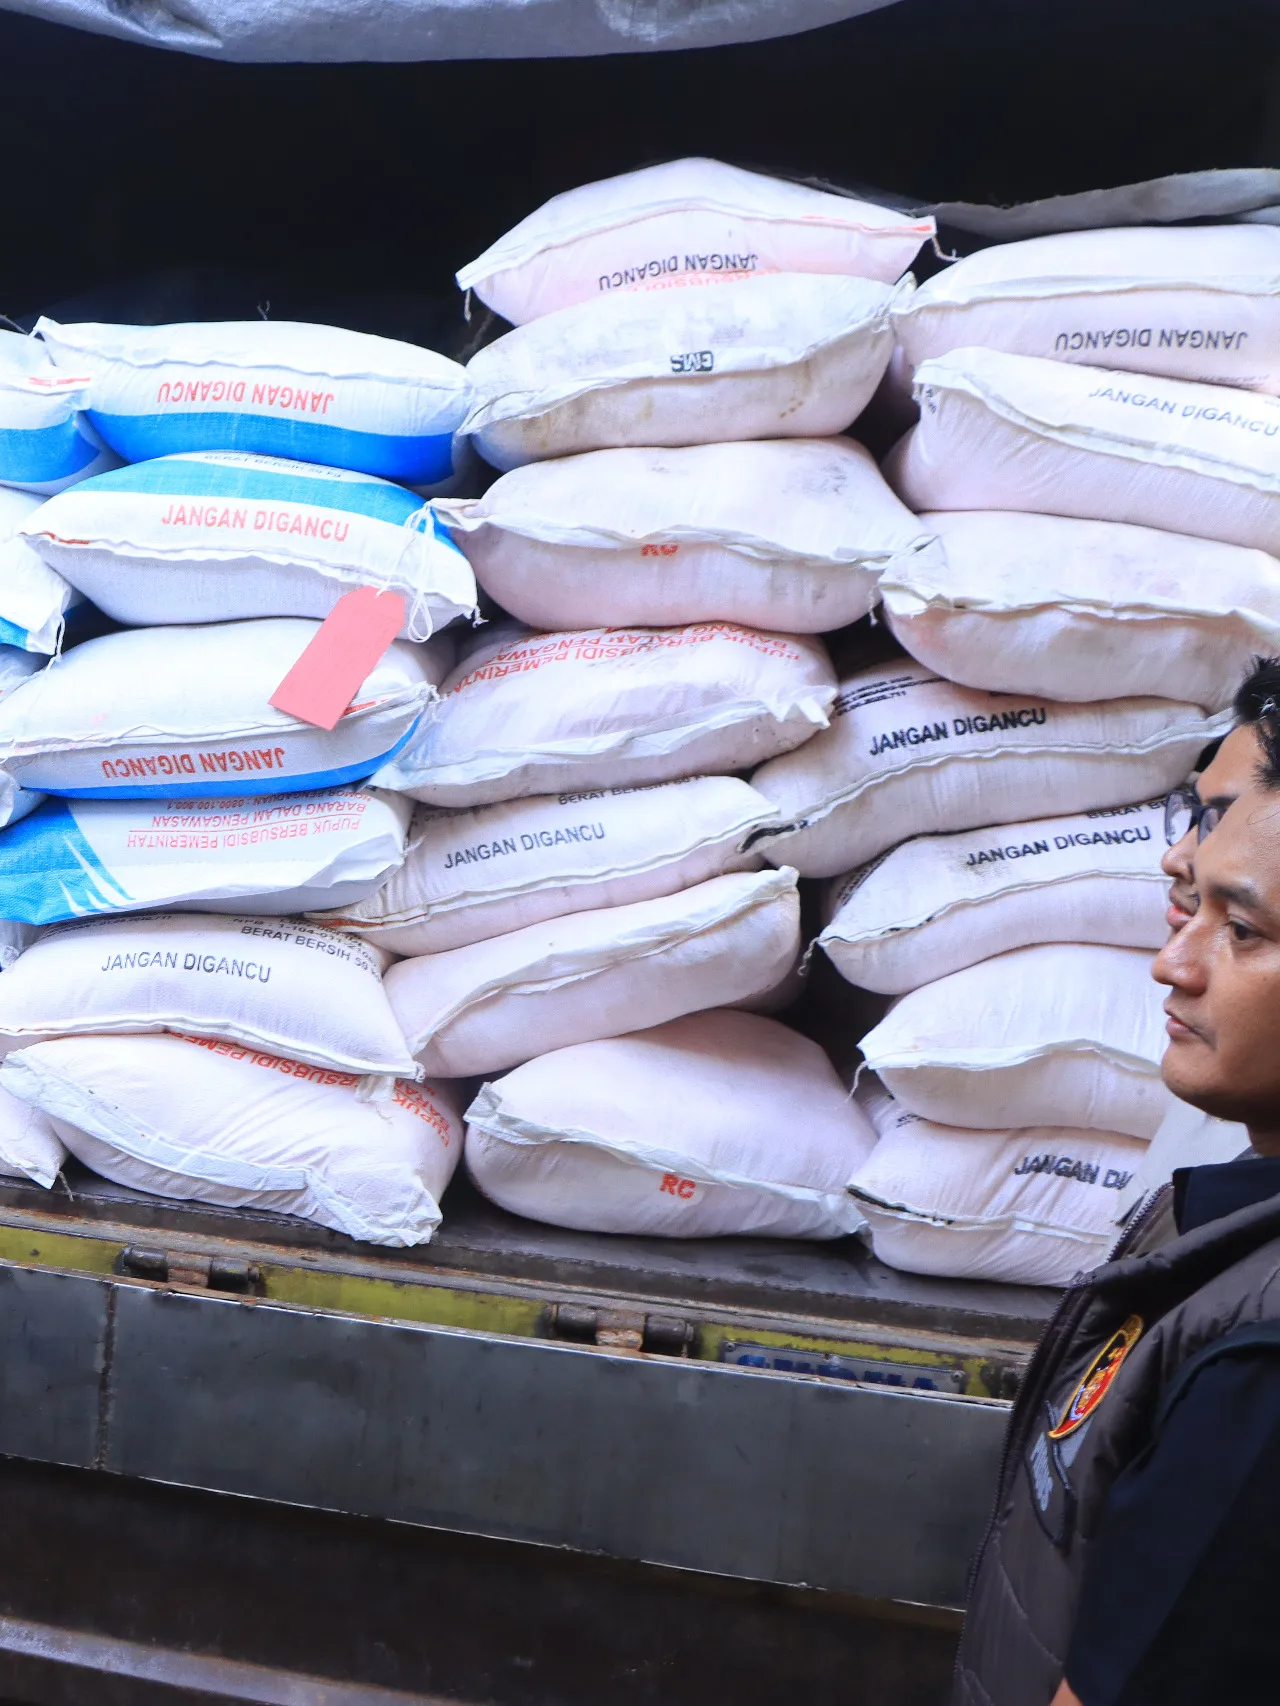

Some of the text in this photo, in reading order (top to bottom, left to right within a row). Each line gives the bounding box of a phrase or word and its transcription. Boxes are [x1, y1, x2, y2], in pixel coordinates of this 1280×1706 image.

[599, 253, 759, 290] JANGAN DIGANCU
[1055, 328, 1248, 352] JANGAN DIGANCU
[157, 381, 334, 414] JANGAN DIGANCU
[1088, 386, 1280, 437] JANGAN DIGANCU
[161, 504, 350, 542] JANGAN DIGANCU
[869, 707, 1048, 756] JANGAN DIGANCU
[101, 747, 286, 779] JANGAN DIGANCU
[151, 800, 366, 828] BARANG DALAM PENGAWASAN
[127, 817, 362, 849] PUPUK BERSUBSIDI PEMERINTAH
[443, 823, 606, 869] JANGAN DIGANCU
[966, 826, 1152, 867] JANGAN DIGANCU
[241, 925, 293, 942] BERAT
[295, 936, 351, 961] BERSIH
[101, 951, 271, 983] JANGAN DIGANCU
[250, 1054, 360, 1088] RSUBSIDI
[1014, 1155, 1100, 1185] JANGAN
